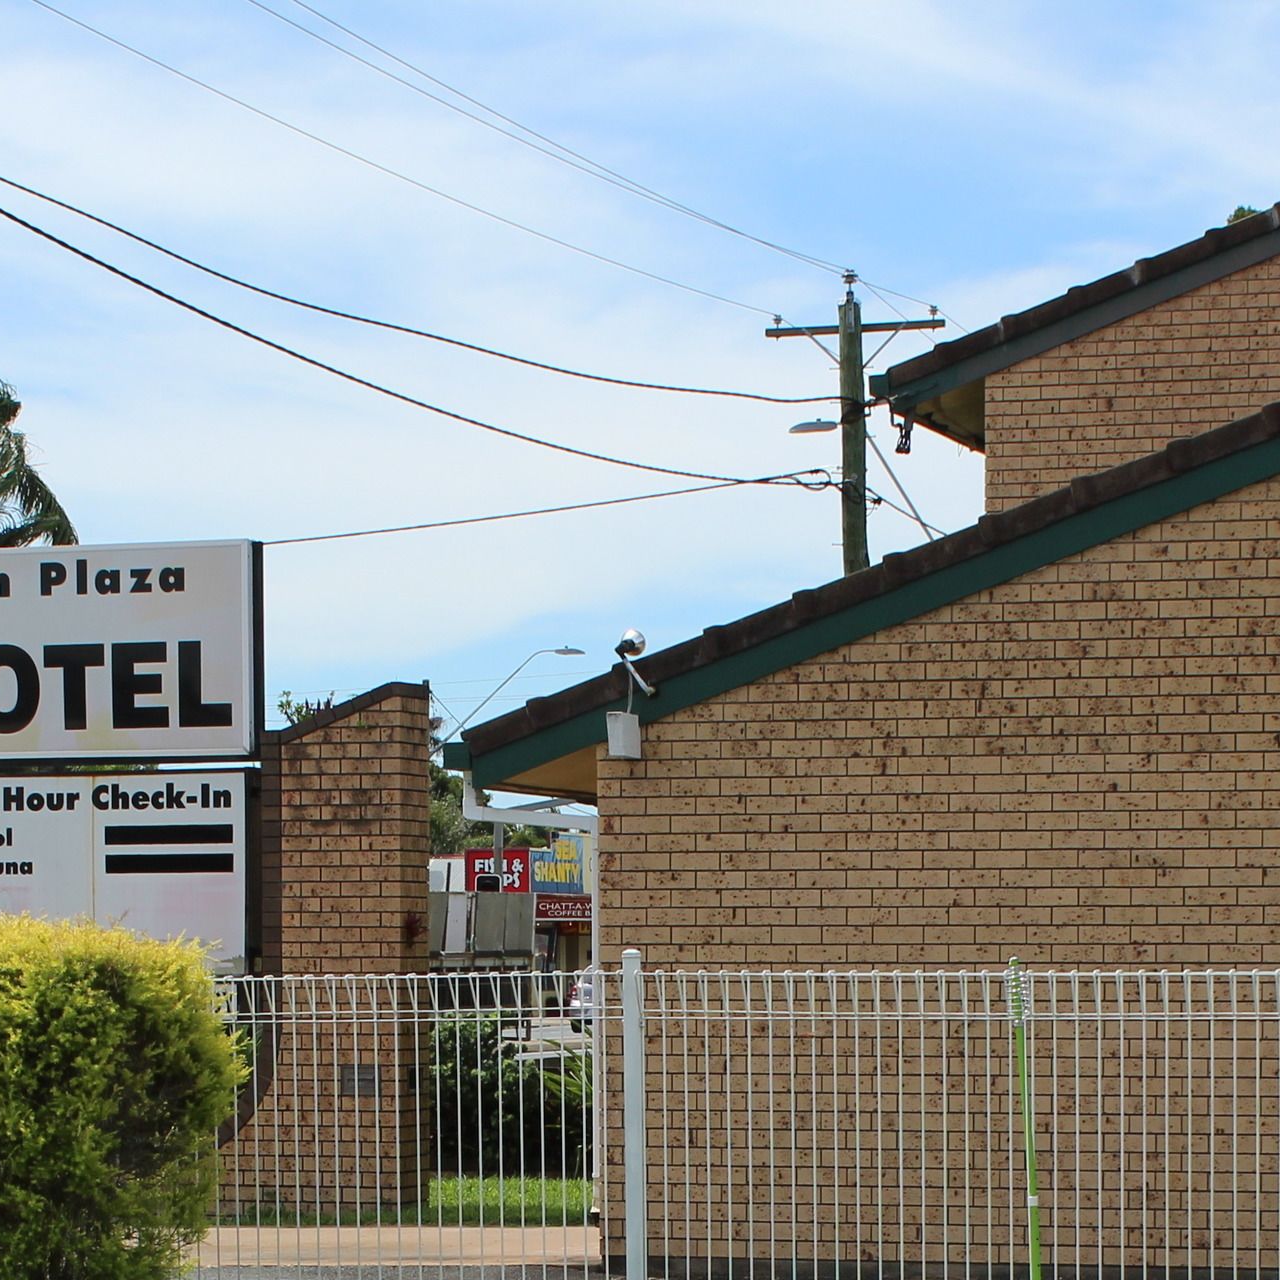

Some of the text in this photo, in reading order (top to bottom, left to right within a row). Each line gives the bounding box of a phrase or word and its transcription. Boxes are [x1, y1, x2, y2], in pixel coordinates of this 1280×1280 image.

[39, 559, 186, 596] Plaza
[3, 786, 80, 812] Hour
[92, 783, 232, 811] Check-In
[511, 859, 524, 873] &
[534, 861, 579, 883] SHANTY
